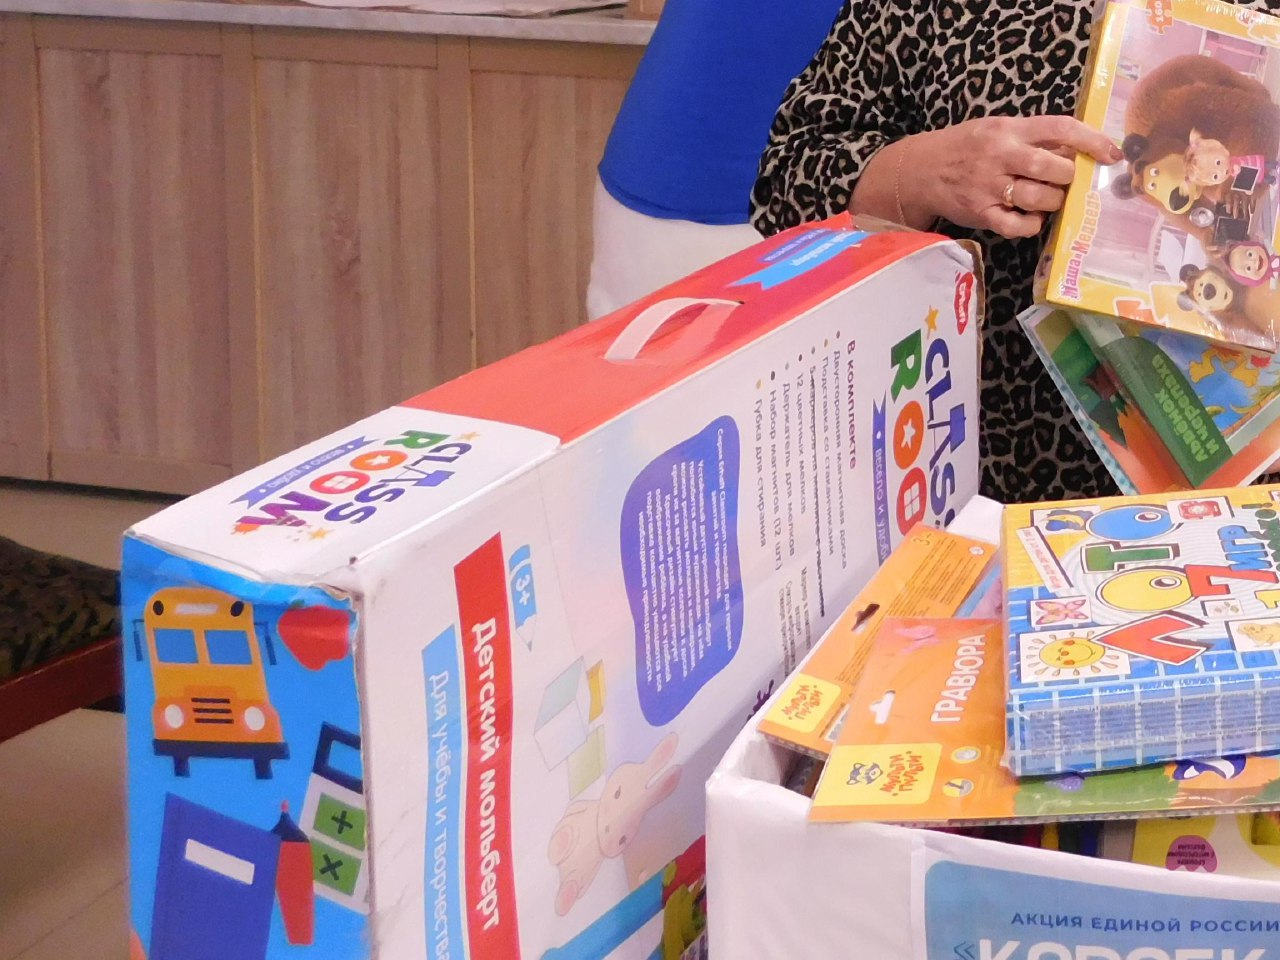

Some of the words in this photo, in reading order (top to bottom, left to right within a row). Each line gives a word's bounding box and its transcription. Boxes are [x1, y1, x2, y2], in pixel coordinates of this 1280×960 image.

[796, 373, 804, 388] 12
[847, 340, 856, 355] В
[754, 399, 763, 441] Губка
[769, 390, 777, 440] Набор
[796, 393, 804, 456] цветных
[821, 356, 829, 433] Подставка
[833, 350, 842, 448] Двусторонняя
[847, 360, 857, 470] комплекте
[716, 428, 724, 459] Серия
[824, 436, 830, 452] со
[891, 328, 928, 536] ROO
[236, 430, 451, 527] ROOM
[323, 442, 472, 525] CLASS
[771, 444, 780, 515] магнитов
[782, 383, 791, 467] Держатель
[787, 502, 795, 557] мелков
[837, 452, 845, 525] магнитная
[874, 448, 888, 500] весело
[719, 490, 728, 540] Classroom
[757, 478, 766, 547] стирания
[773, 518, 782, 537] (12
[825, 456, 834, 556] стаканчиками
[876, 505, 886, 515] и
[514, 574, 534, 607] 3+
[1081, 504, 1208, 666] ЛОТО
[1184, 564, 1279, 598] 7
[428, 670, 449, 717] Для
[472, 618, 500, 760] Детский
[929, 634, 986, 723] ГРАВЮРА
[428, 724, 452, 802] учёбы
[433, 809, 447, 825] и
[476, 769, 501, 930] мольберт
[430, 829, 448, 960] творчества
[1011, 912, 1082, 929] АКЦИЯ
[1091, 915, 1180, 933] ЕДИНОЙ
[1190, 919, 1280, 932] РОССИИ
